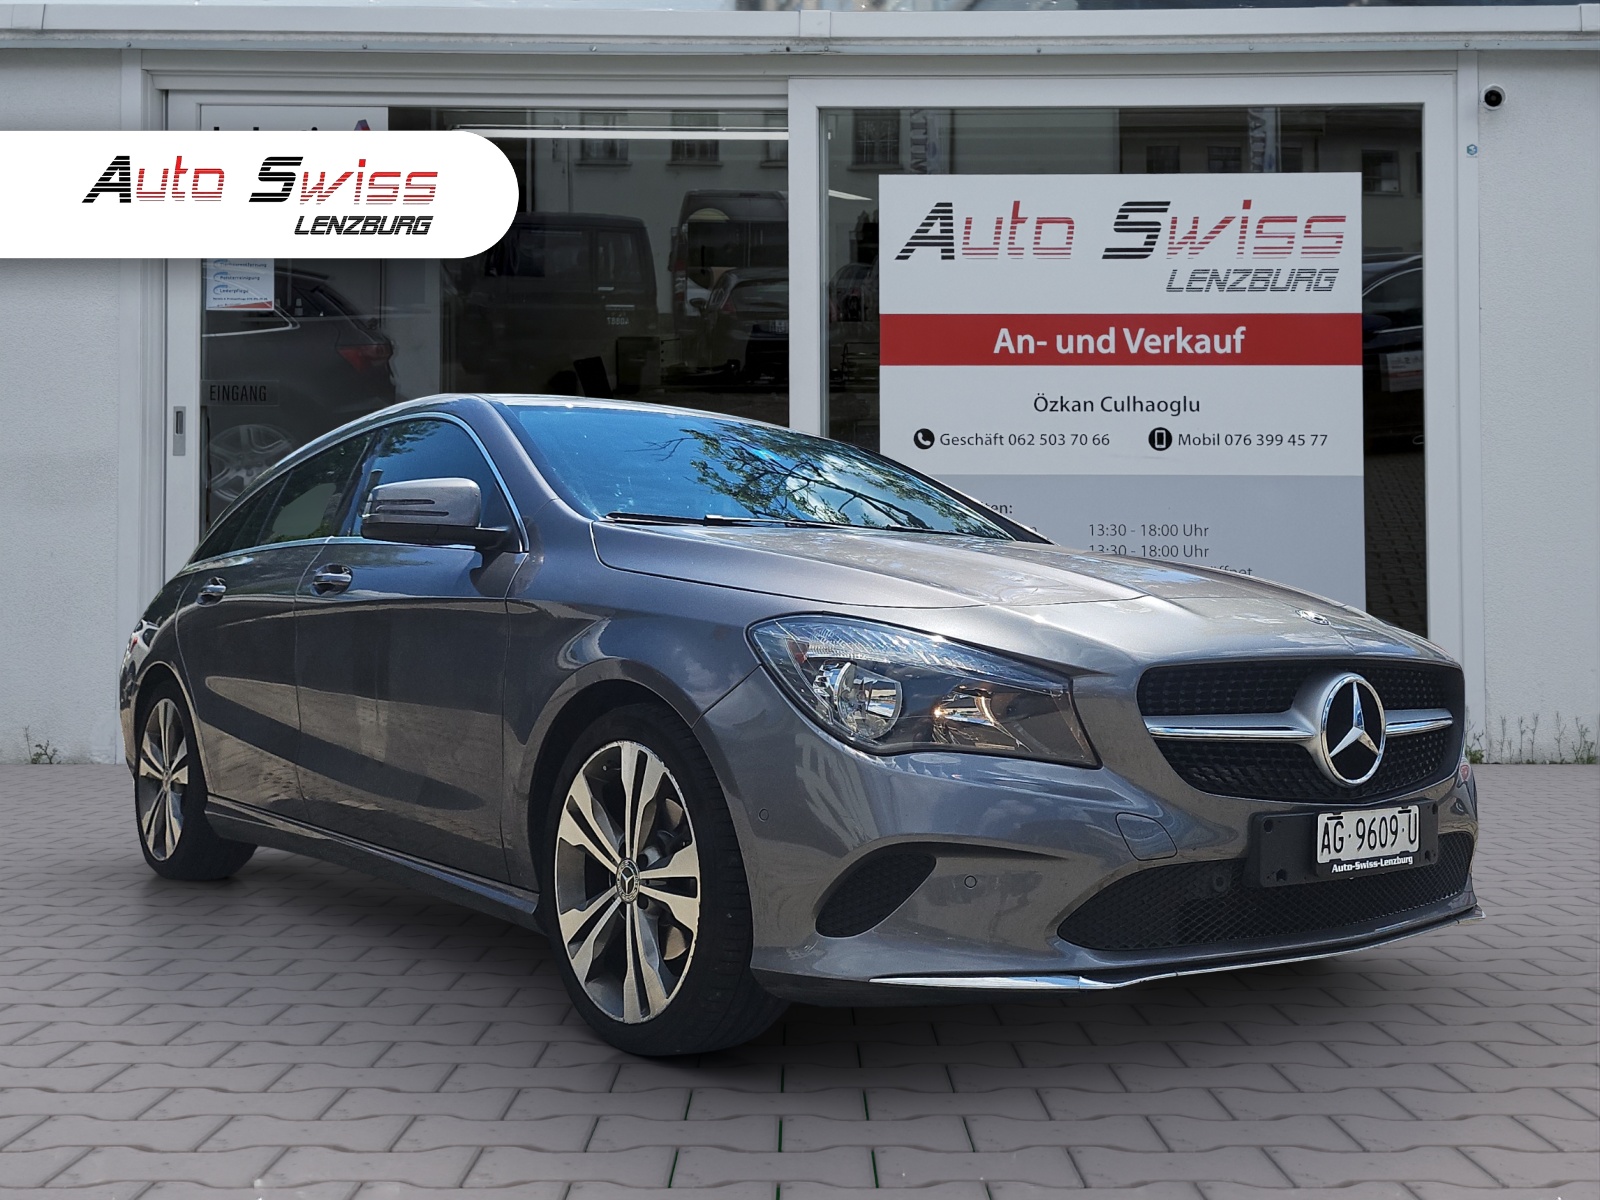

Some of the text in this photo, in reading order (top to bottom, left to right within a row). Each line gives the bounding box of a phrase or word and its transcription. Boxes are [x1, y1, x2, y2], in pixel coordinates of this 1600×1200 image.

[894, 199, 1346, 260] Auto Swiss
[1166, 269, 1339, 293] LENZBURG
[993, 326, 1247, 355] An- und Verkauf
[209, 384, 267, 402] EINGANG
[1033, 393, 1200, 417] Özkan Culhaoglu
[939, 432, 1110, 446] Geschäft 062 503 70 66
[1178, 432, 1328, 447] Mobil 076 399 45 77
[1089, 524, 1127, 537] 13:30
[1140, 524, 1179, 537] 18:00
[1182, 523, 1210, 537] Uhr
[1140, 544, 1179, 557] 18:00
[1182, 544, 1210, 558] Uhr
[1331, 856, 1414, 874] Auto-Swiss-Lenzburg
